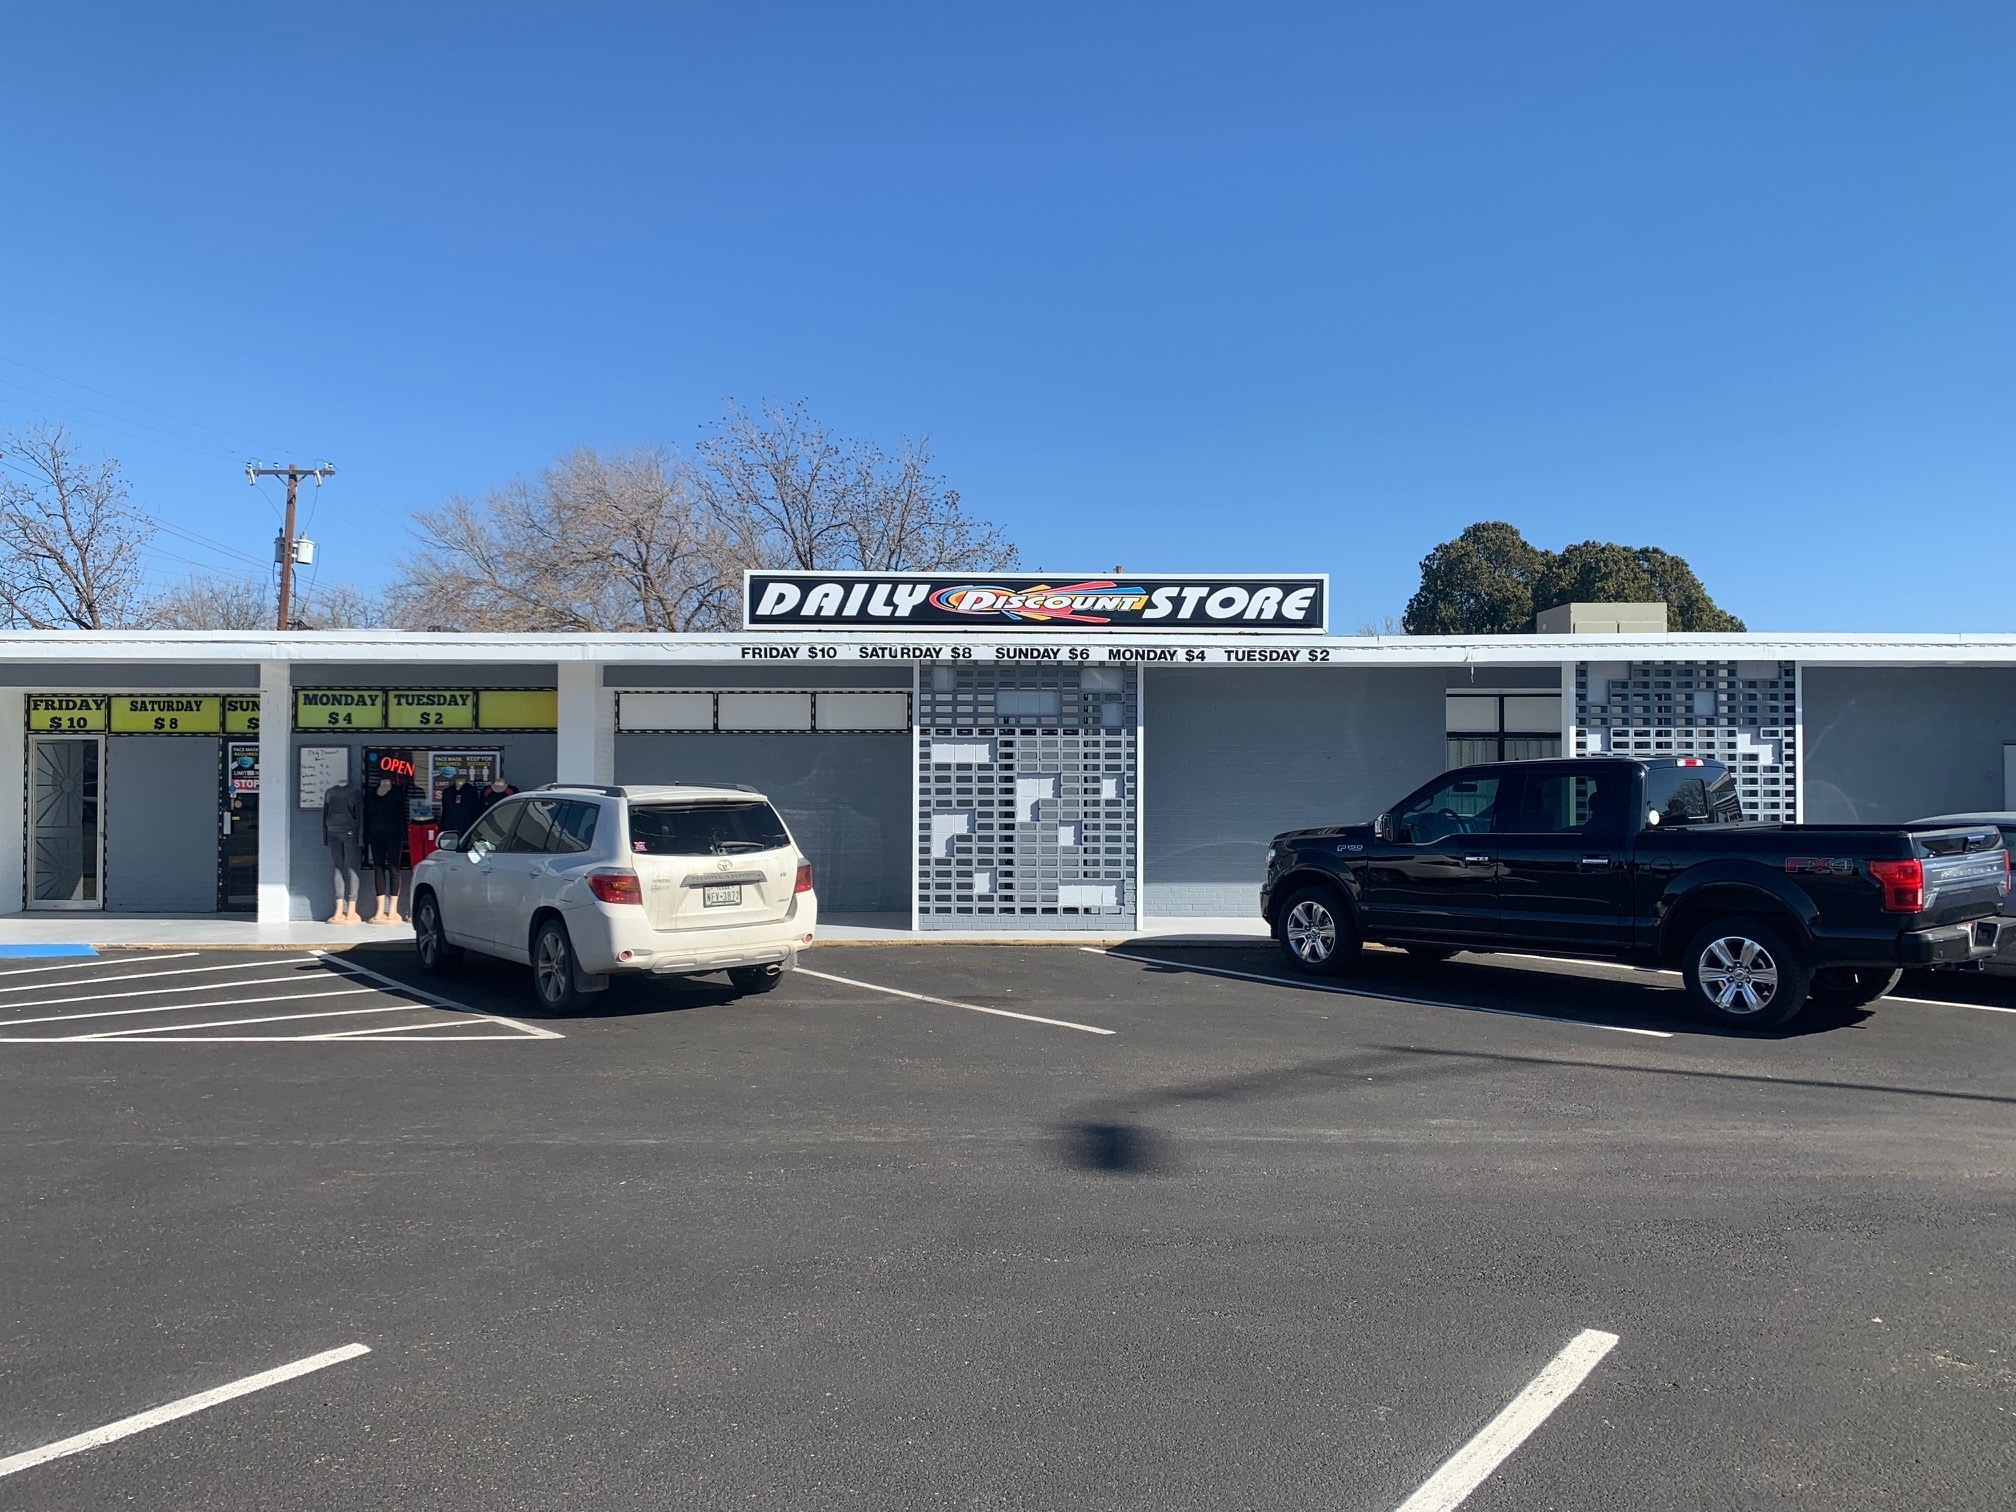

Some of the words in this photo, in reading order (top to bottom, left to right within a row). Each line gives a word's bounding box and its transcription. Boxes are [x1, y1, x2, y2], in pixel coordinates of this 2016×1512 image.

[755, 582, 931, 617] DAILY
[1142, 586, 1316, 620] STORE
[741, 647, 800, 659] FRIDAY
[808, 646, 837, 660] $10
[859, 647, 943, 660] SATURDAY
[950, 646, 972, 660] $8
[995, 647, 1060, 661] SUNDAY
[1068, 648, 1090, 661] $6
[1108, 649, 1178, 661] MONDAY
[1184, 648, 1206, 662] $4
[1224, 649, 1300, 662] TUESDAY
[1307, 649, 1330, 663] $2
[32, 699, 105, 711] FRIDAY
[130, 700, 203, 712] SATURDAY
[303, 694, 379, 706] MONDAY
[394, 694, 470, 706] TUESDAY
[380, 756, 415, 776] OPEN
[1785, 856, 1854, 873] FX4
